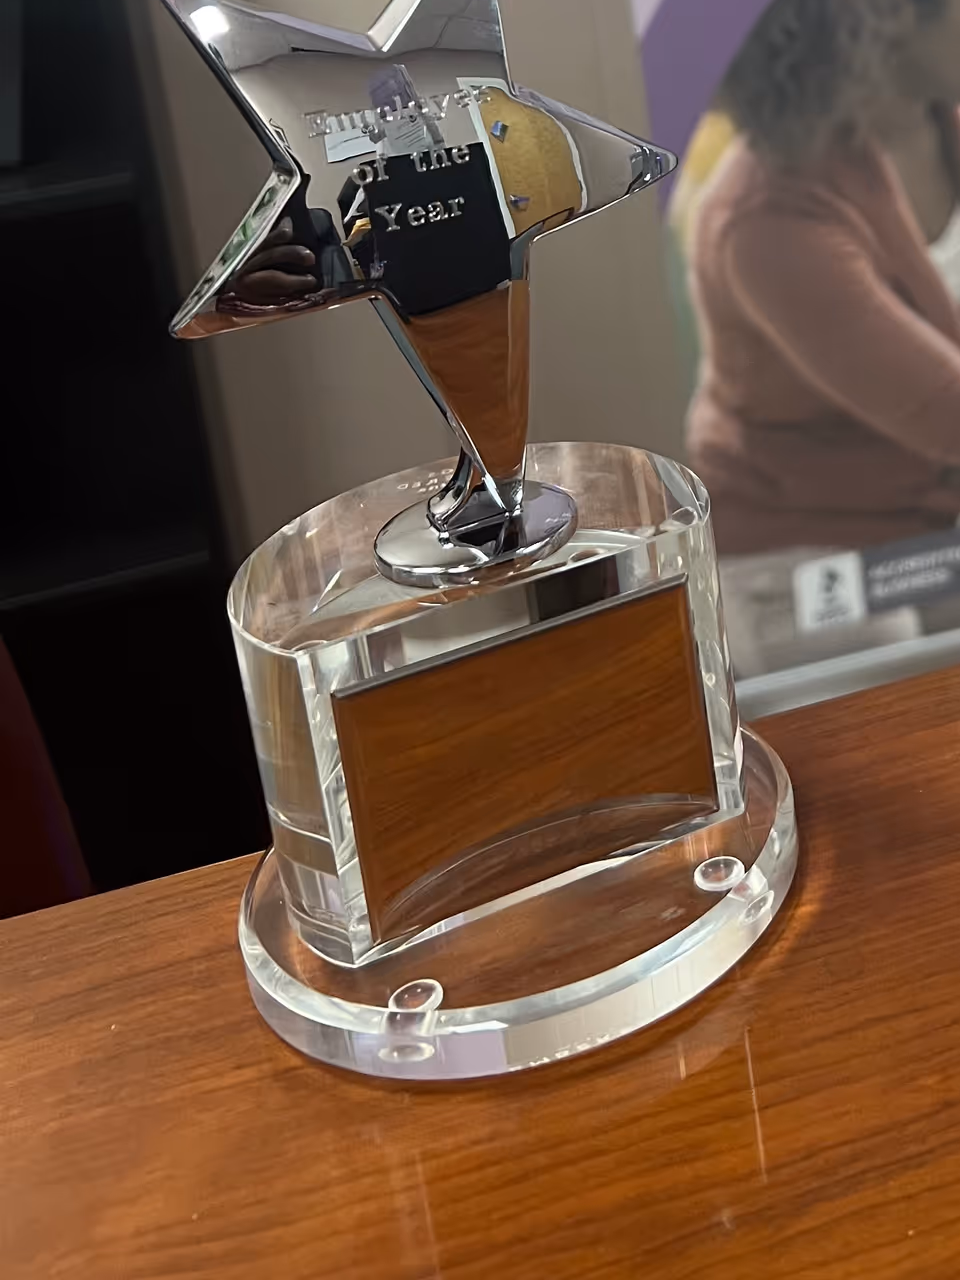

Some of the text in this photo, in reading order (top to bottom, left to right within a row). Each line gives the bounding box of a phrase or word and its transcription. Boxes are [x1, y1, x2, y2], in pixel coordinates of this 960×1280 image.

[351, 142, 472, 186] of the
[375, 195, 467, 233] Year
